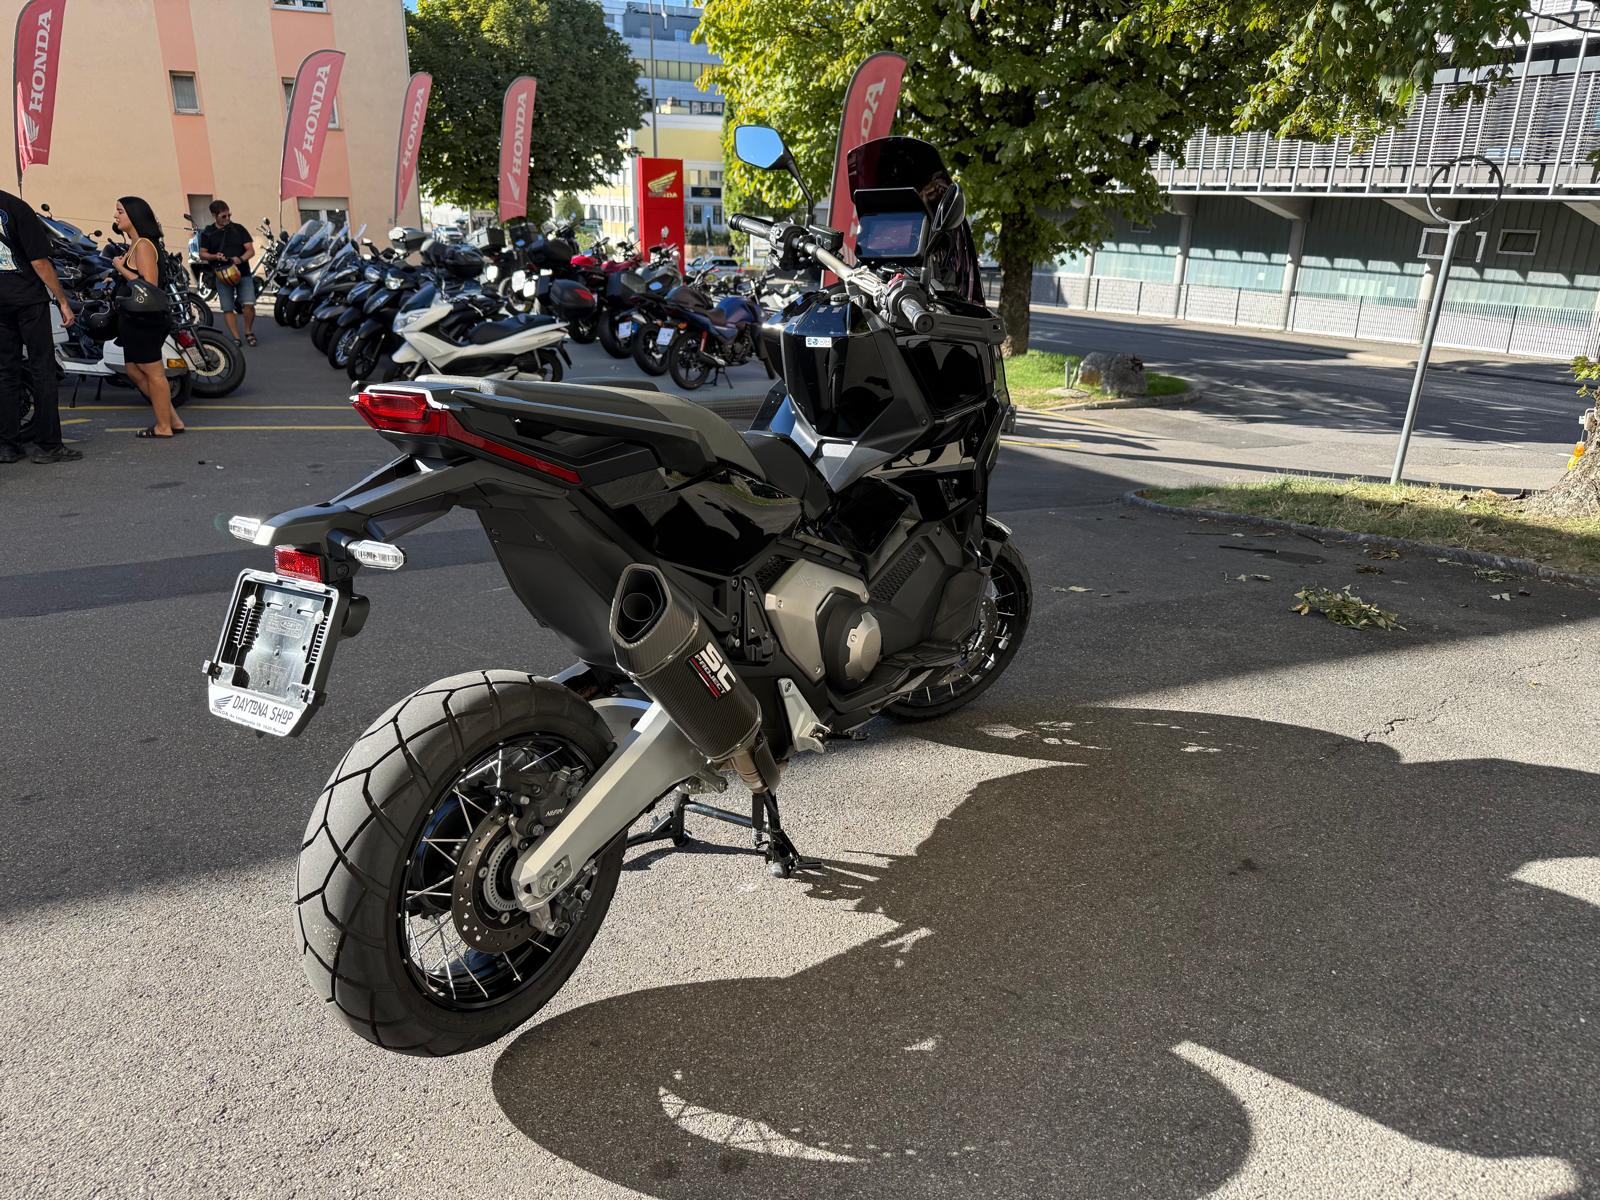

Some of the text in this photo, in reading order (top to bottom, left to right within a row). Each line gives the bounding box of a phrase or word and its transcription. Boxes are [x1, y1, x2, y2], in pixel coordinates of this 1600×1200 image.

[29, 9, 52, 113] HONDA
[302, 63, 332, 154] HONDA
[402, 87, 425, 168] HONDA
[512, 91, 528, 176] HONDA
[694, 653, 727, 694] PROJECT
[699, 641, 737, 692] SC
[232, 695, 269, 718] DAYTONA
[269, 706, 294, 726] SHOP
